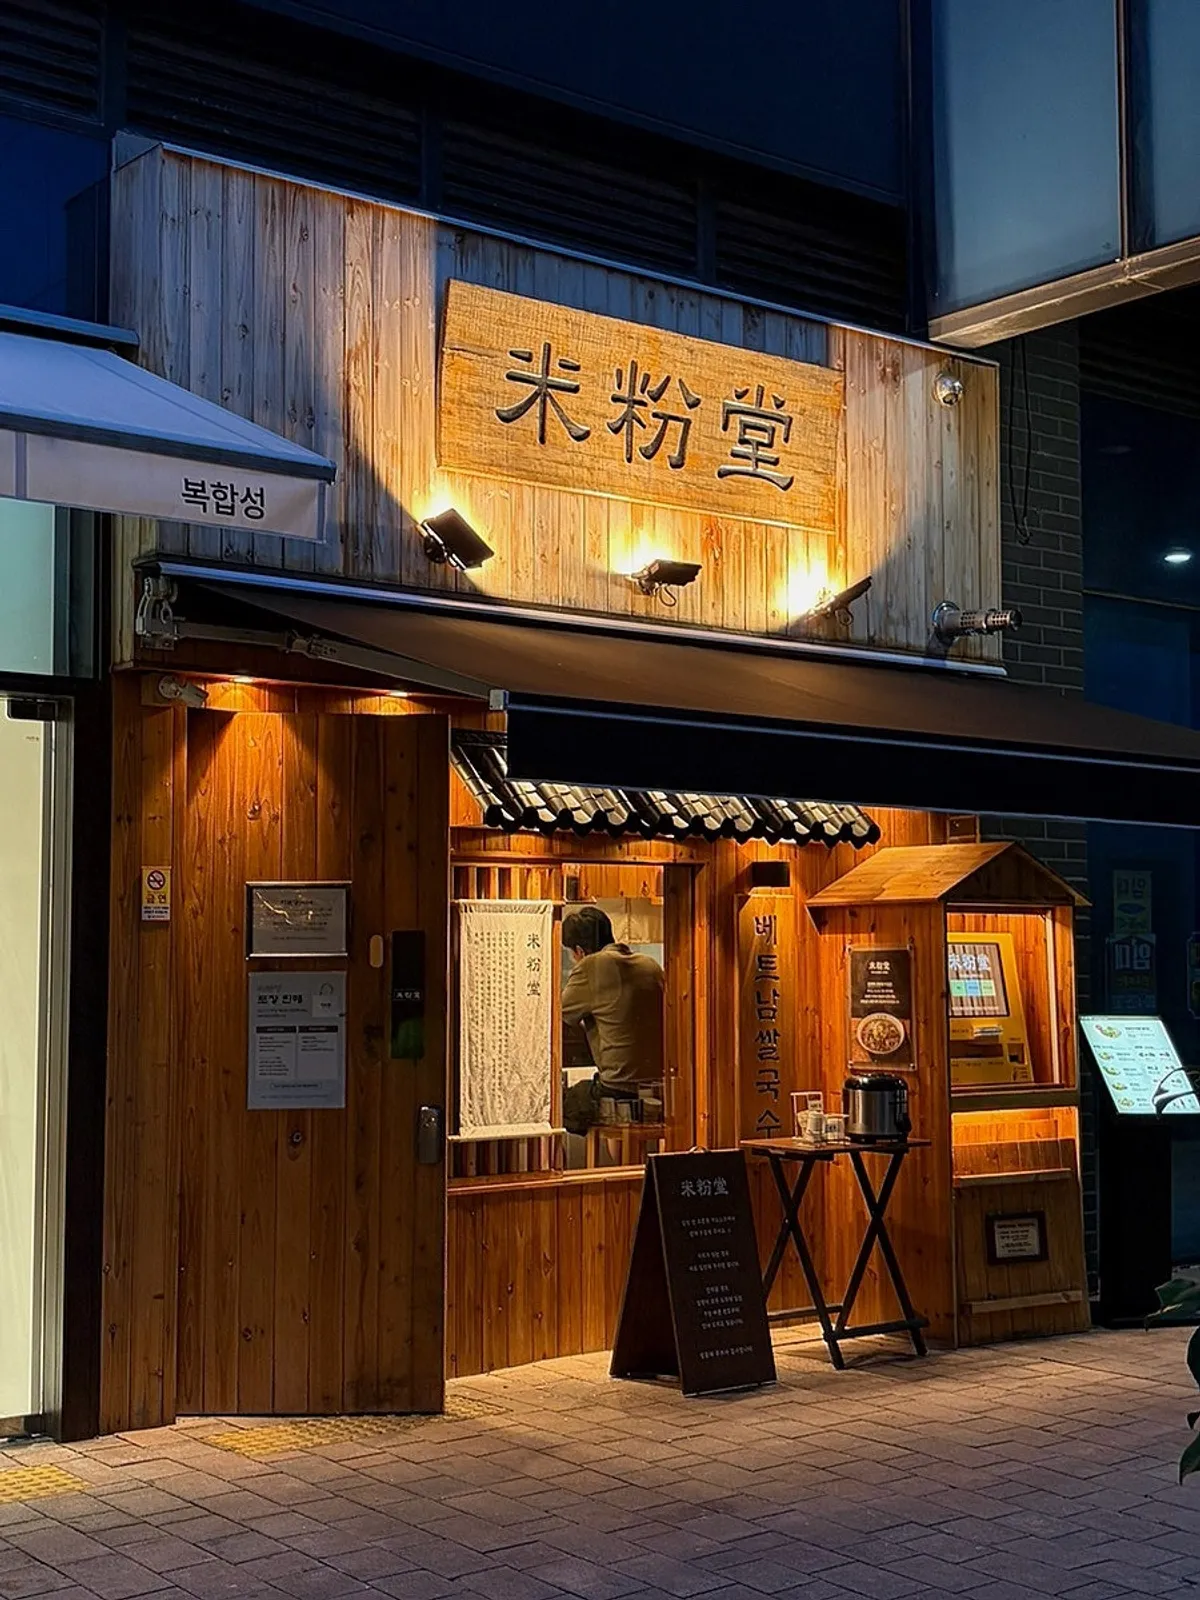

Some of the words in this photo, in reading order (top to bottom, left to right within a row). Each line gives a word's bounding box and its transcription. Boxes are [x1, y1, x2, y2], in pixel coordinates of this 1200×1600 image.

[495, 342, 794, 491] 米粉堂
[181, 477, 265, 520] 복합성
[527, 933, 541, 997] 米粉堂
[948, 954, 991, 972] 米粉堂
[680, 1176, 729, 1197] 米粉堂
